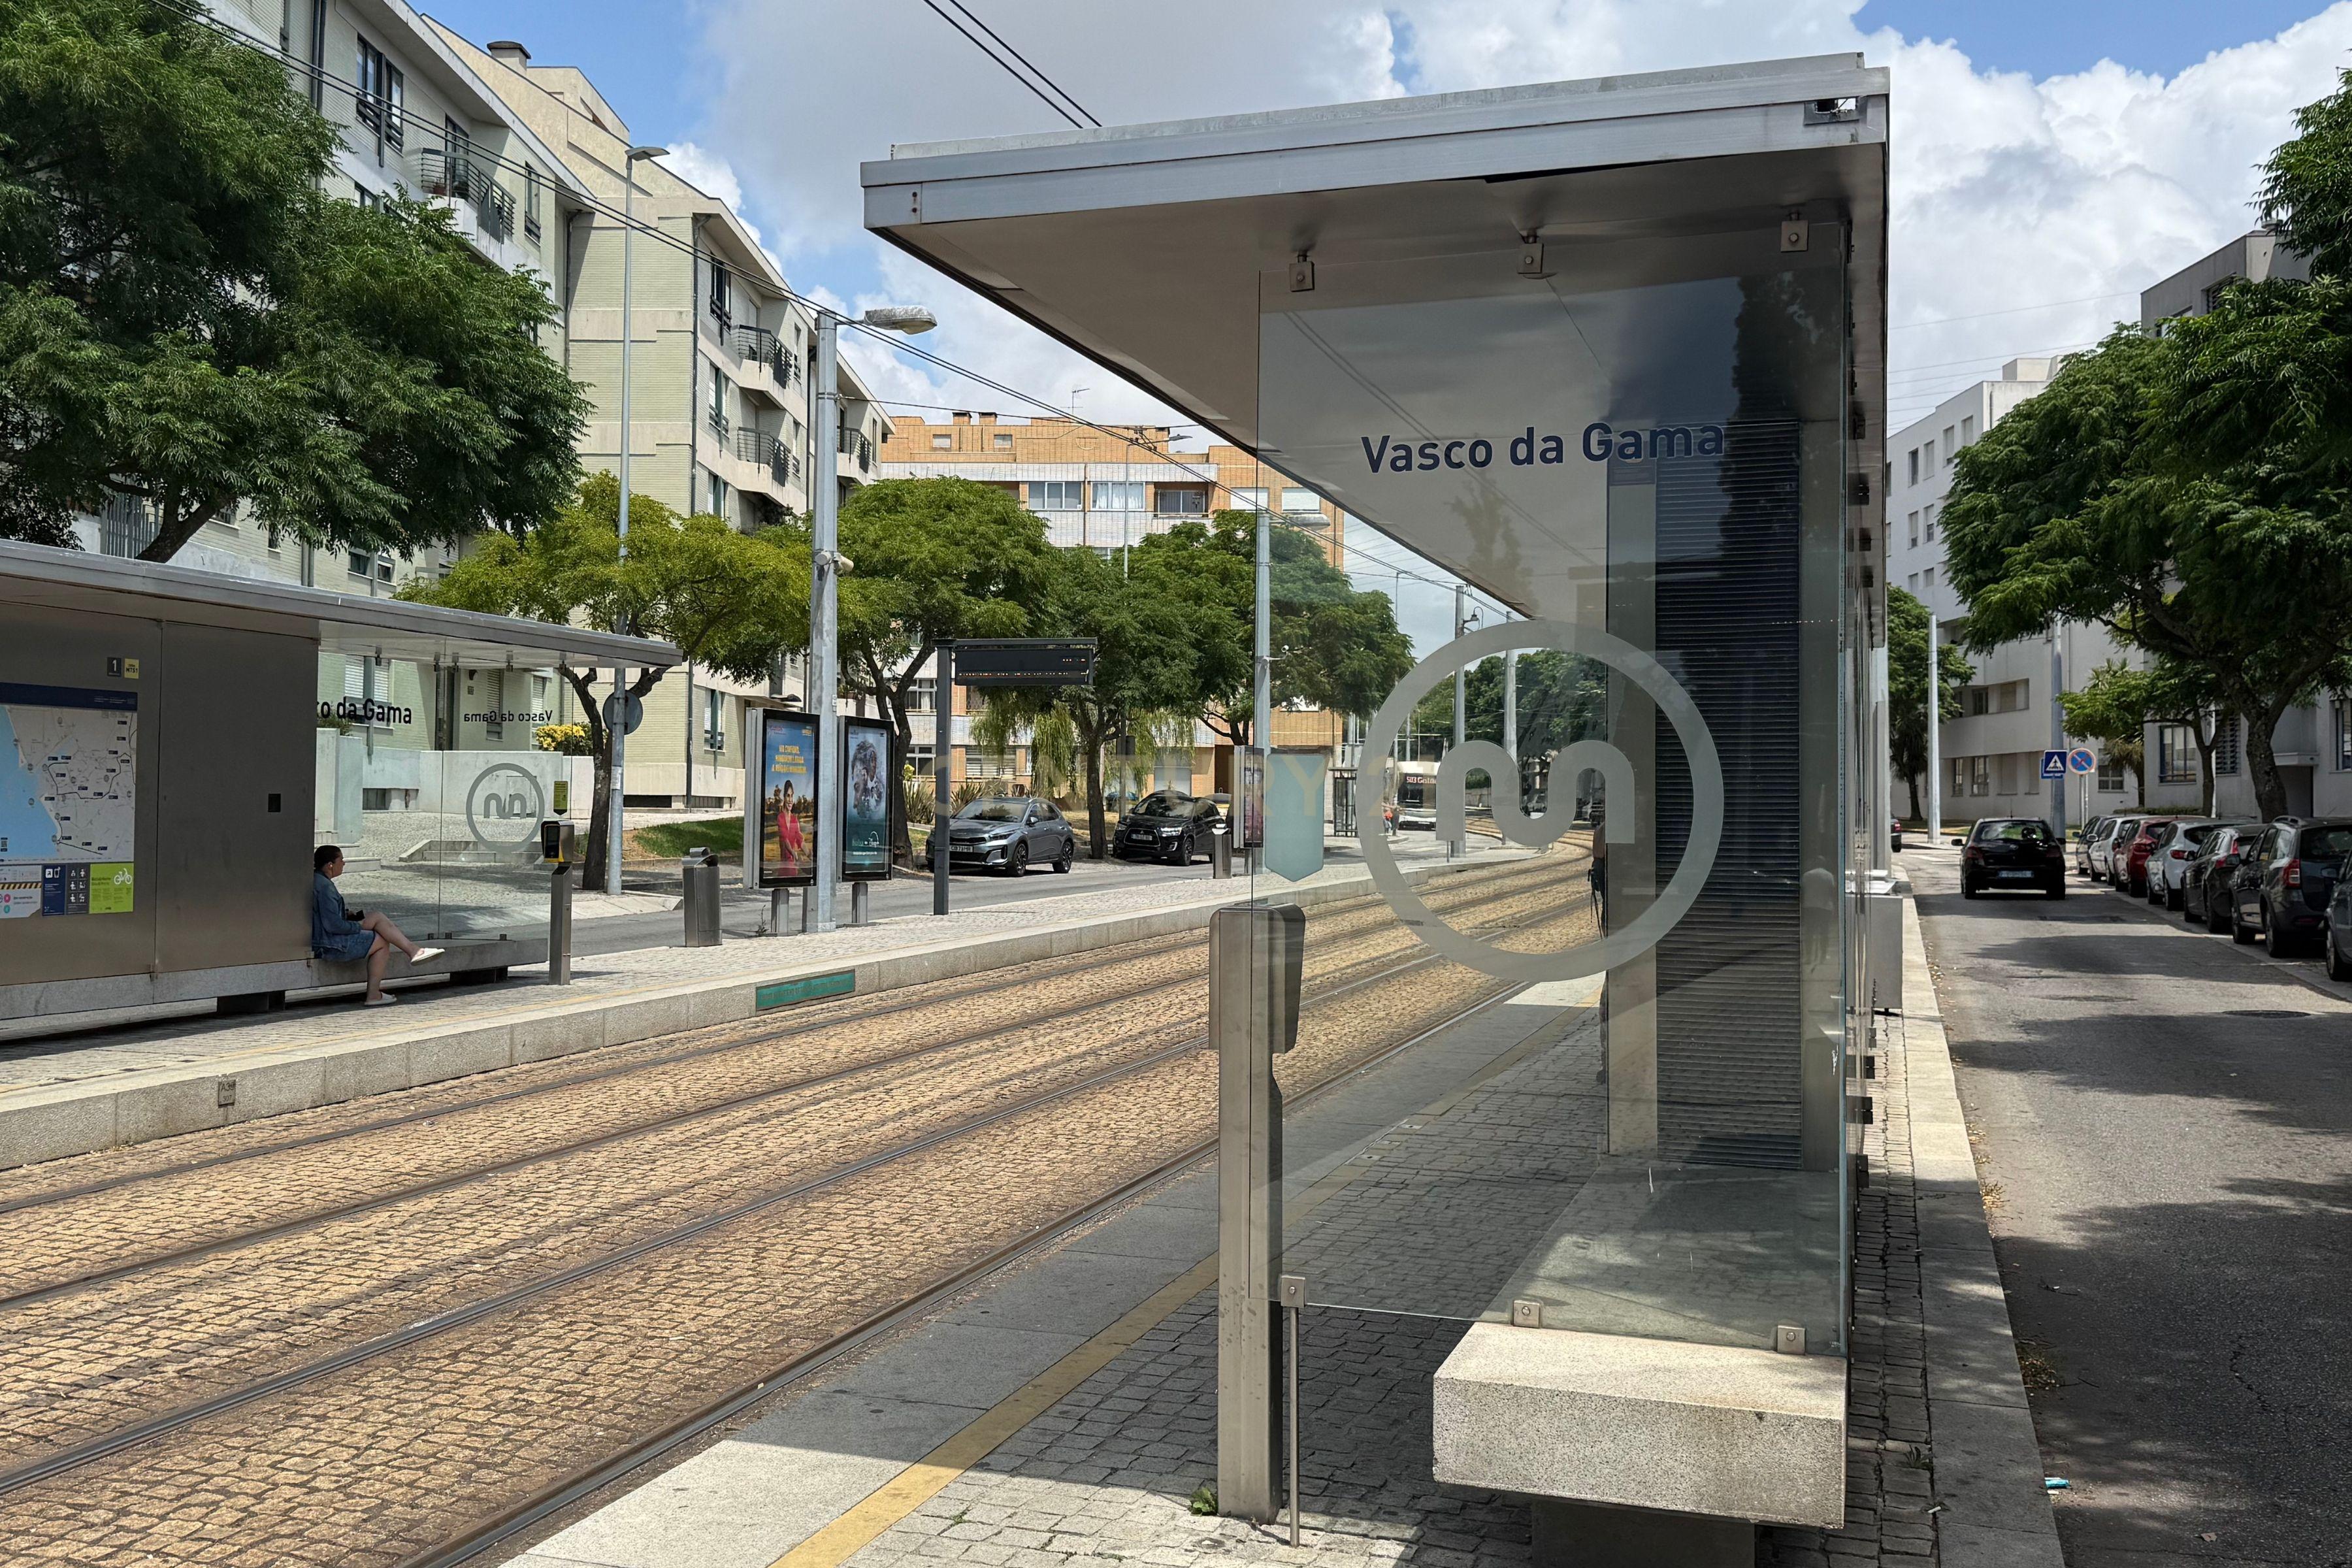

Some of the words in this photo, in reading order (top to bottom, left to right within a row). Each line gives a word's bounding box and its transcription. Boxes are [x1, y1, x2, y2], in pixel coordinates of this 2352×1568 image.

[1361, 434, 1492, 473] Vasco
[1509, 426, 1563, 466] da
[1582, 422, 1724, 462] Gama
[112, 659, 117, 672] 1
[336, 696, 357, 719] da
[363, 698, 412, 724] Gama
